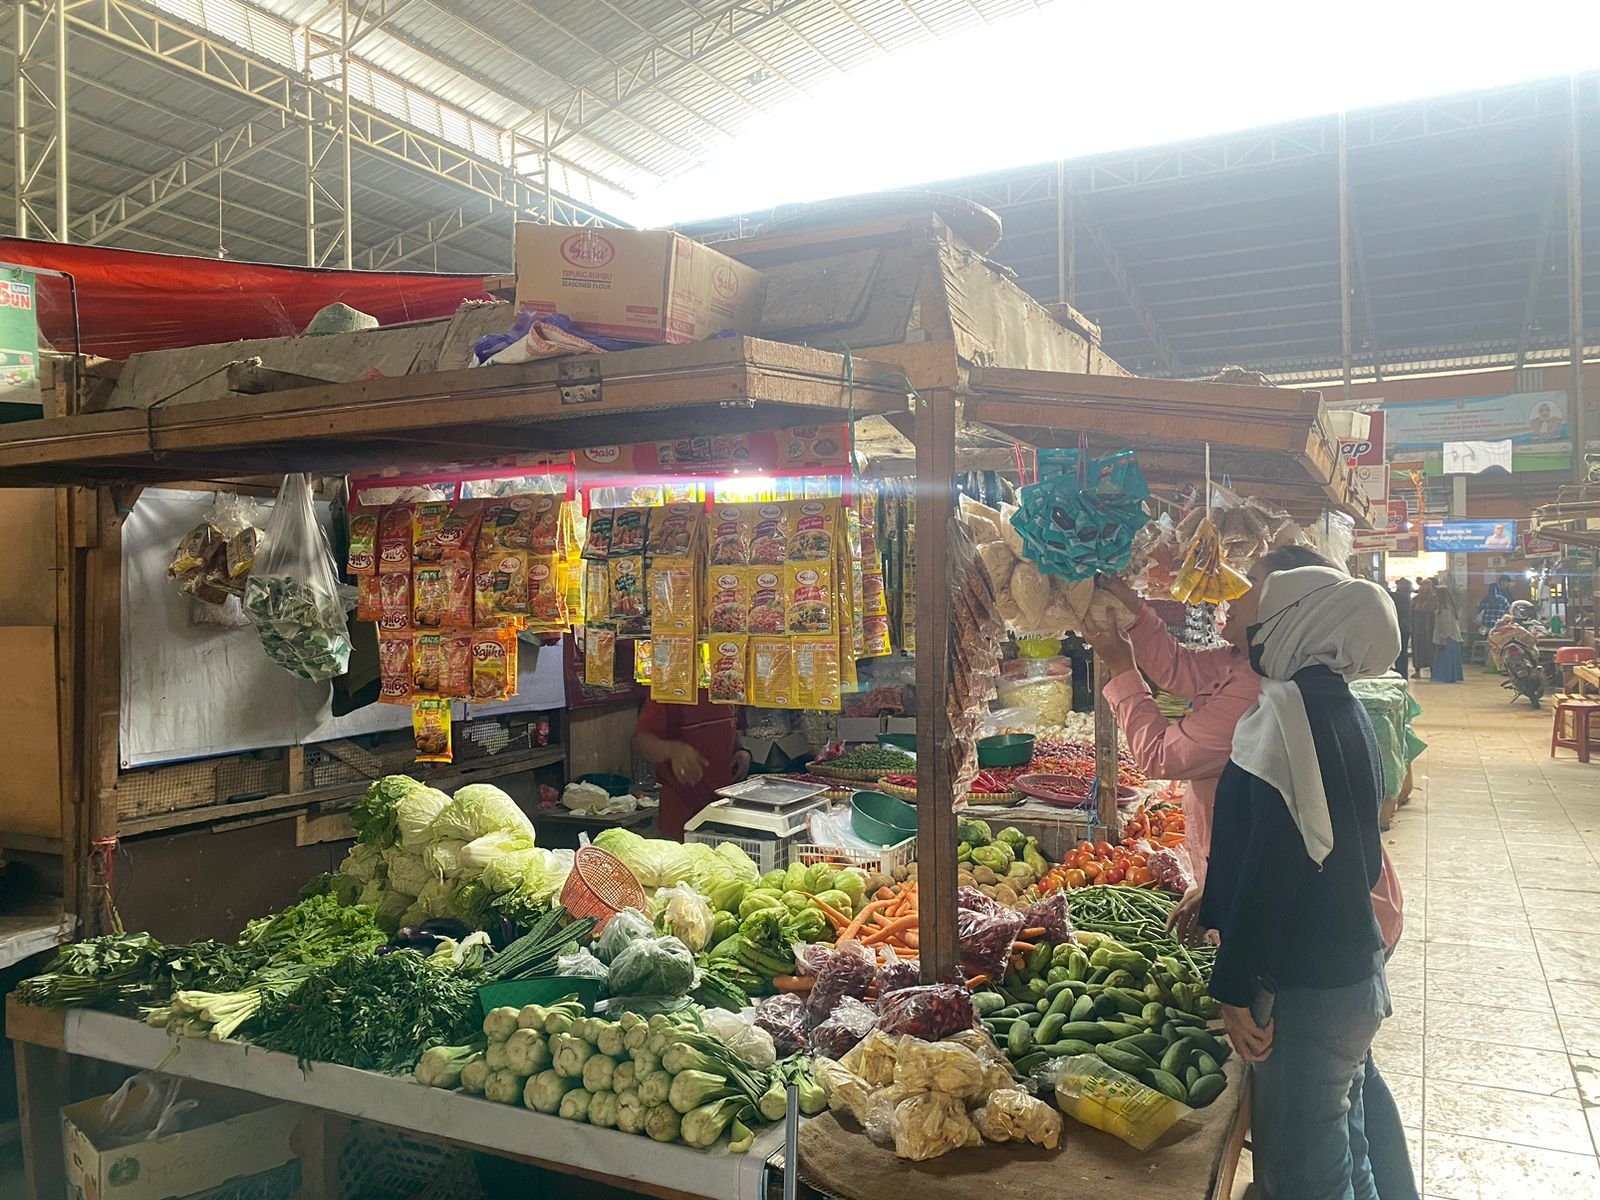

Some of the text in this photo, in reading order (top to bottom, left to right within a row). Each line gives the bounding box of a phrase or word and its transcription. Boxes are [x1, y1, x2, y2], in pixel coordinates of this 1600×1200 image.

[561, 280, 592, 289] SEASONED
[590, 447, 614, 459] Sasa
[473, 644, 505, 661] Sajiku
